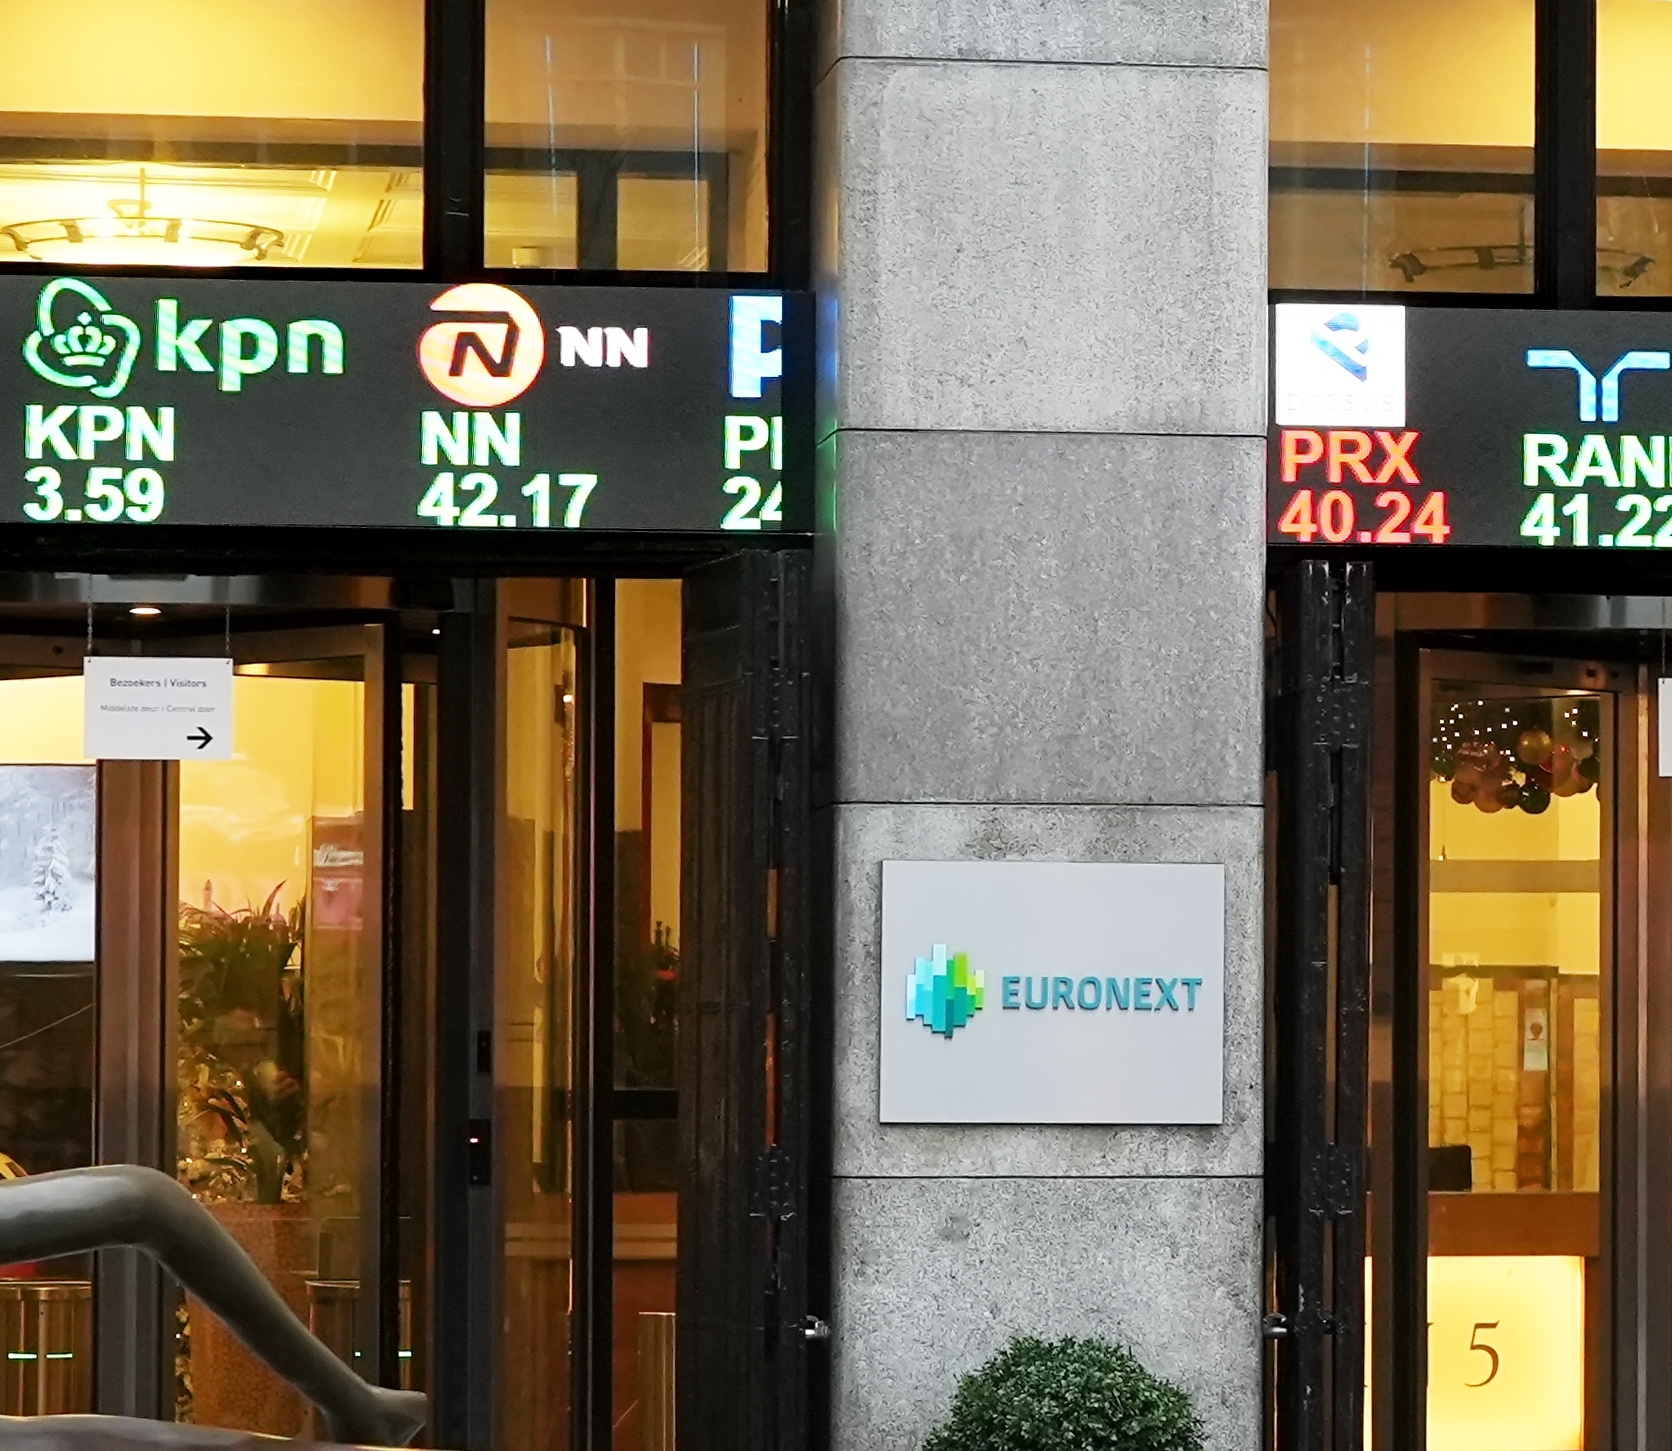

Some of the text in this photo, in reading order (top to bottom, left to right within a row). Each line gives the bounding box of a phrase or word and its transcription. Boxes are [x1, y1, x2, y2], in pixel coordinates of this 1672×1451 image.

[156, 299, 343, 391] kpn
[555, 325, 648, 367] NN
[25, 405, 175, 461] KPN
[421, 411, 520, 466] NN
[1280, 428, 1421, 485] PRX
[23, 466, 165, 523] 3.59
[417, 472, 597, 528] 42.17
[1277, 489, 1452, 545] 40.24
[109, 677, 161, 688] Bezoekers
[170, 678, 207, 688] Visitors
[1001, 976, 1203, 1011] EURONEXT
[1464, 1319, 1501, 1388] 5
